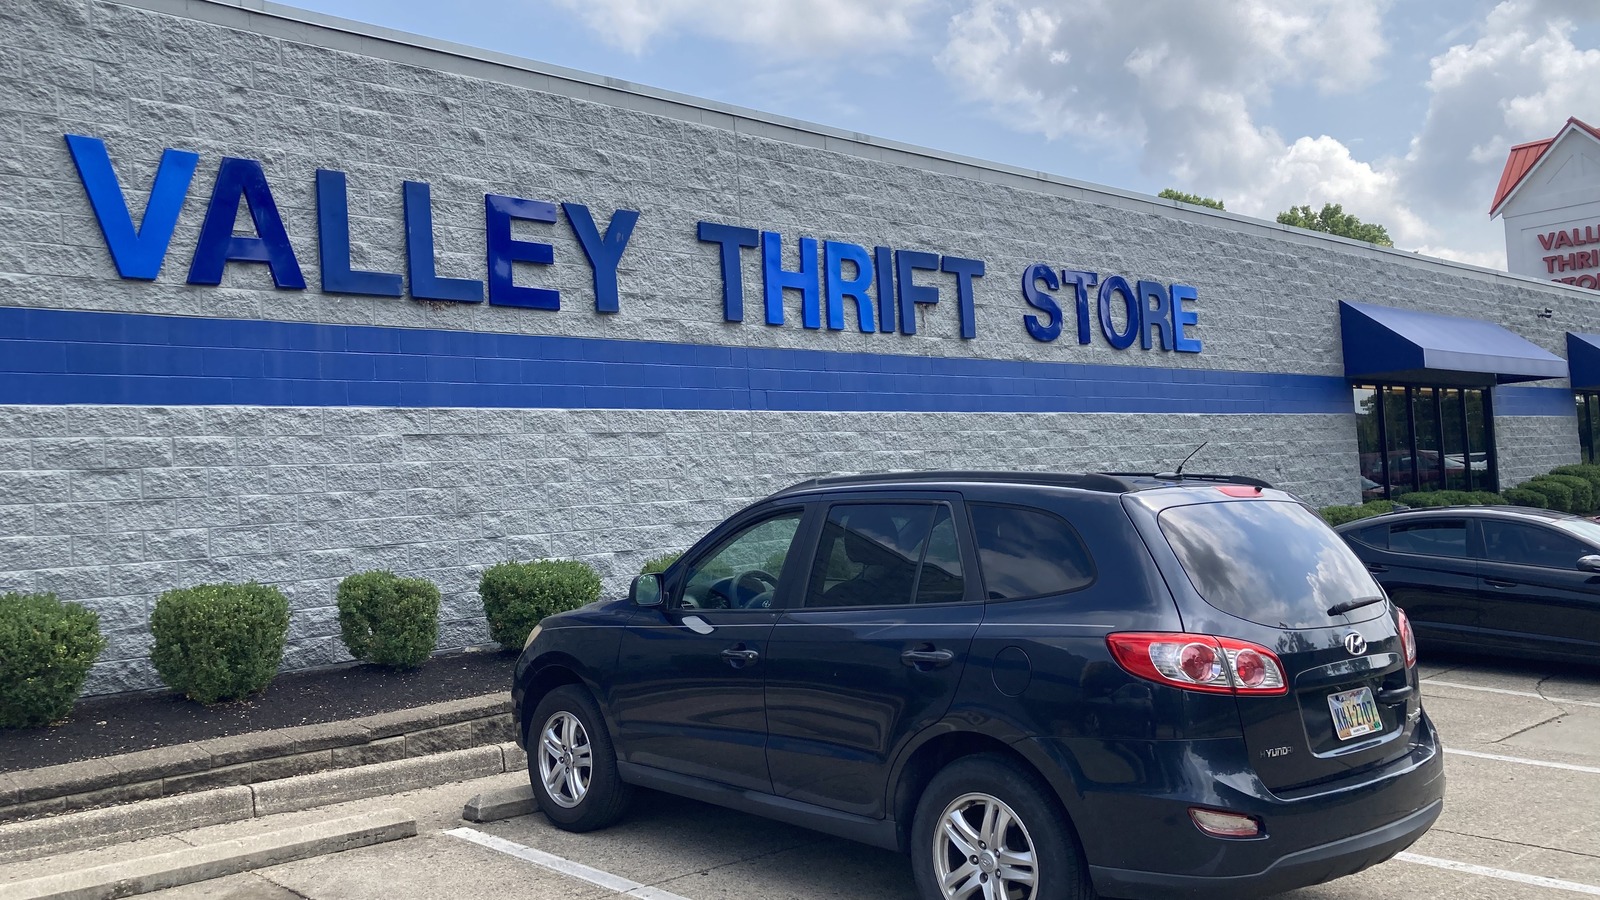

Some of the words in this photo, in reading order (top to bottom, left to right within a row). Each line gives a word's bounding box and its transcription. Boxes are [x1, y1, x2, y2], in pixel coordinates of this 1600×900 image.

[64, 134, 639, 314] VALLEY
[697, 221, 984, 339] THRIFT
[1022, 265, 1202, 354] STORE
[1537, 224, 1600, 250] VALL
[1542, 249, 1600, 274] THRI
